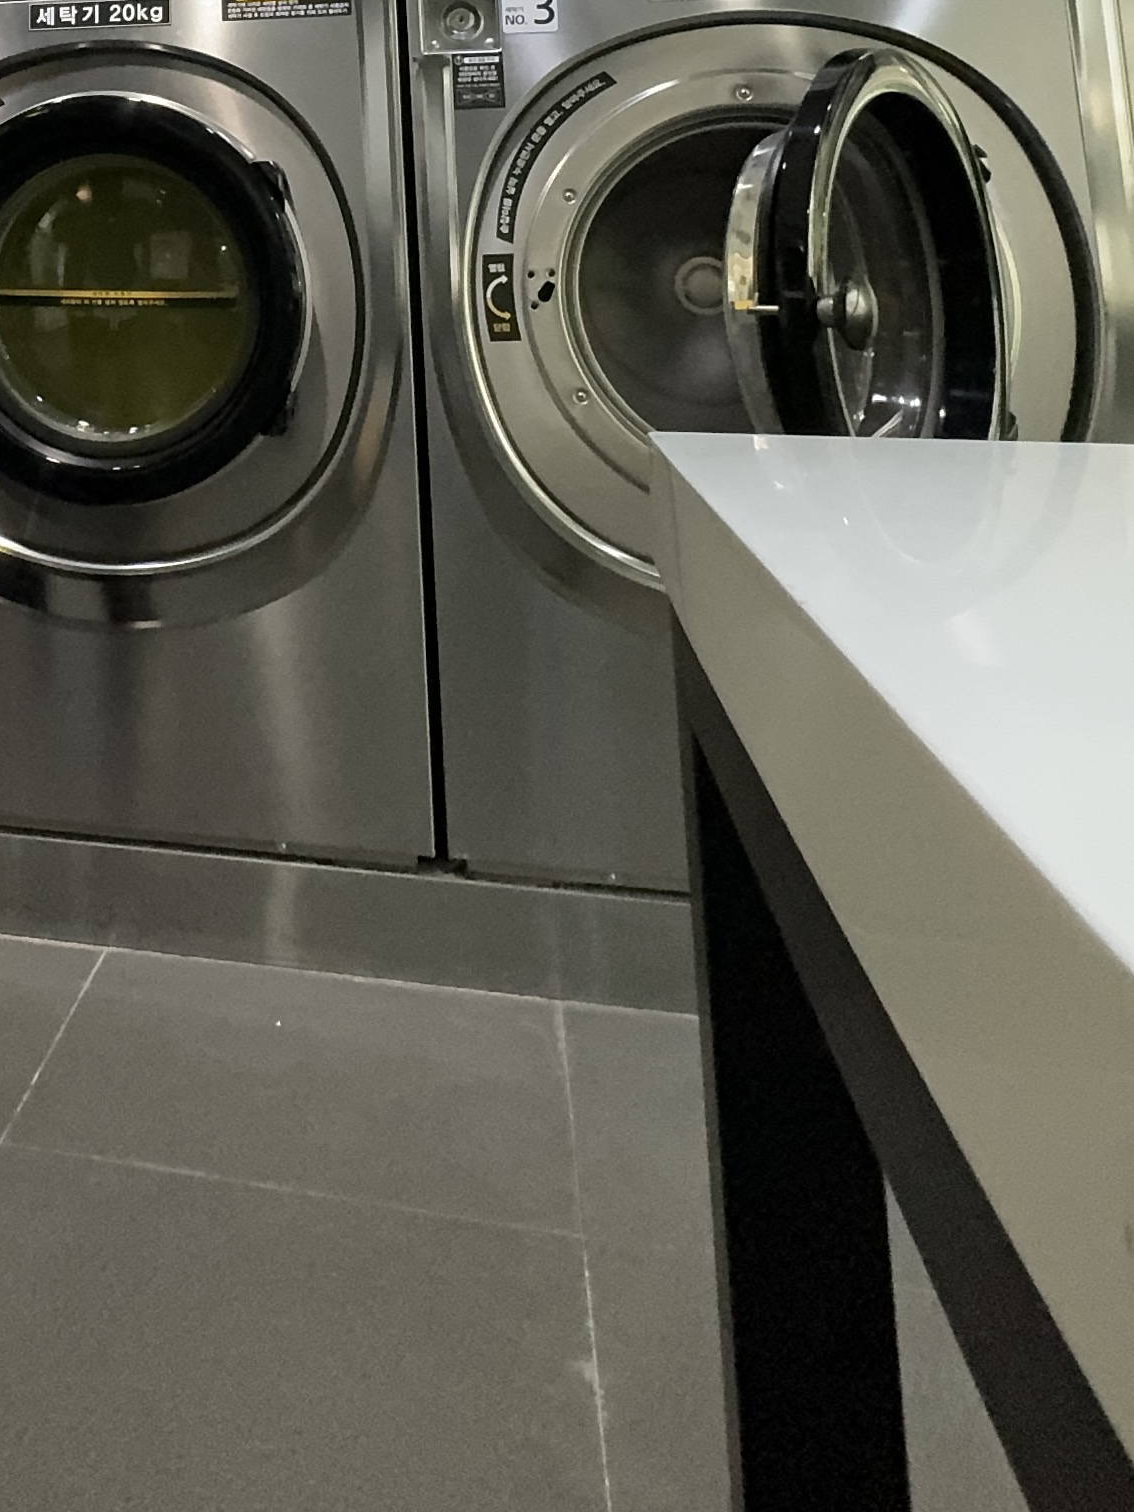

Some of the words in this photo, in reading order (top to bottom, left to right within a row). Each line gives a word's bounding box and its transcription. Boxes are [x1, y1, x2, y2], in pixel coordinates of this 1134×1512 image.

[36, 6, 100, 25] 세탁기
[109, 4, 164, 23] 20kg
[505, 14, 528, 25] NO.
